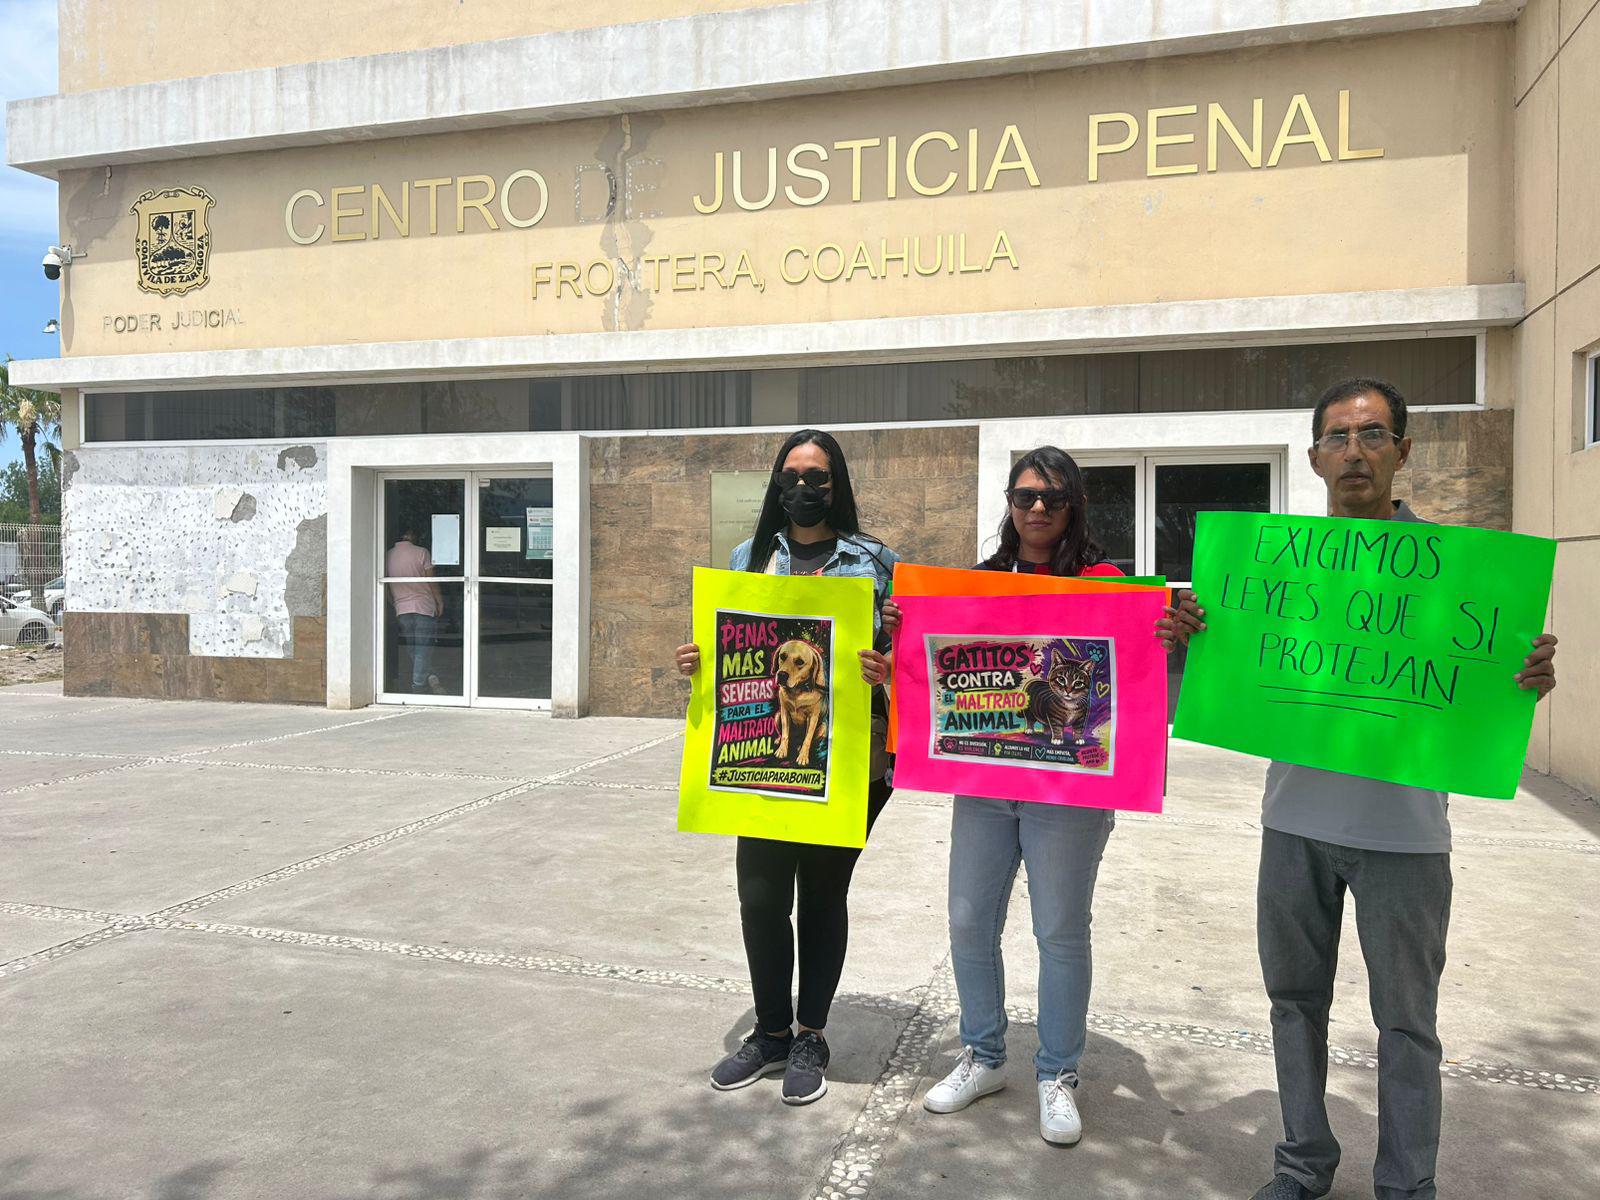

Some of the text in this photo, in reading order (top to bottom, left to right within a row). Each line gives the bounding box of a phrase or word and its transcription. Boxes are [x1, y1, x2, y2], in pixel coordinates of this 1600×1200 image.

[285, 168, 549, 245] CENTRO
[692, 124, 1041, 215] JUSTICIA
[1087, 89, 1385, 183] PENAL
[164, 275, 177, 284] DE
[179, 235, 204, 283] ZARAGOZA
[780, 229, 1020, 284] COAHUILA
[103, 308, 246, 333] PODER JUDICIAL
[1254, 524, 1442, 580] EXIGIMOS
[1220, 573, 1499, 654] LEYES QUE SI
[720, 618, 779, 651] PENAS
[722, 648, 766, 679] MÁS
[939, 645, 1030, 671] GATITOS
[1258, 632, 1460, 704] PROTEJAN
[722, 680, 774, 704] SEVERAS
[947, 671, 1016, 689] CONTRA
[727, 703, 766, 719] PARA EL
[944, 691, 1026, 711] EL MALTRATO
[718, 717, 775, 746] MALTRATO
[944, 711, 1021, 731] ANIMAL
[718, 737, 774, 765] ANIMAL
[718, 768, 821, 785] #JUSTICIAPARABONITA
